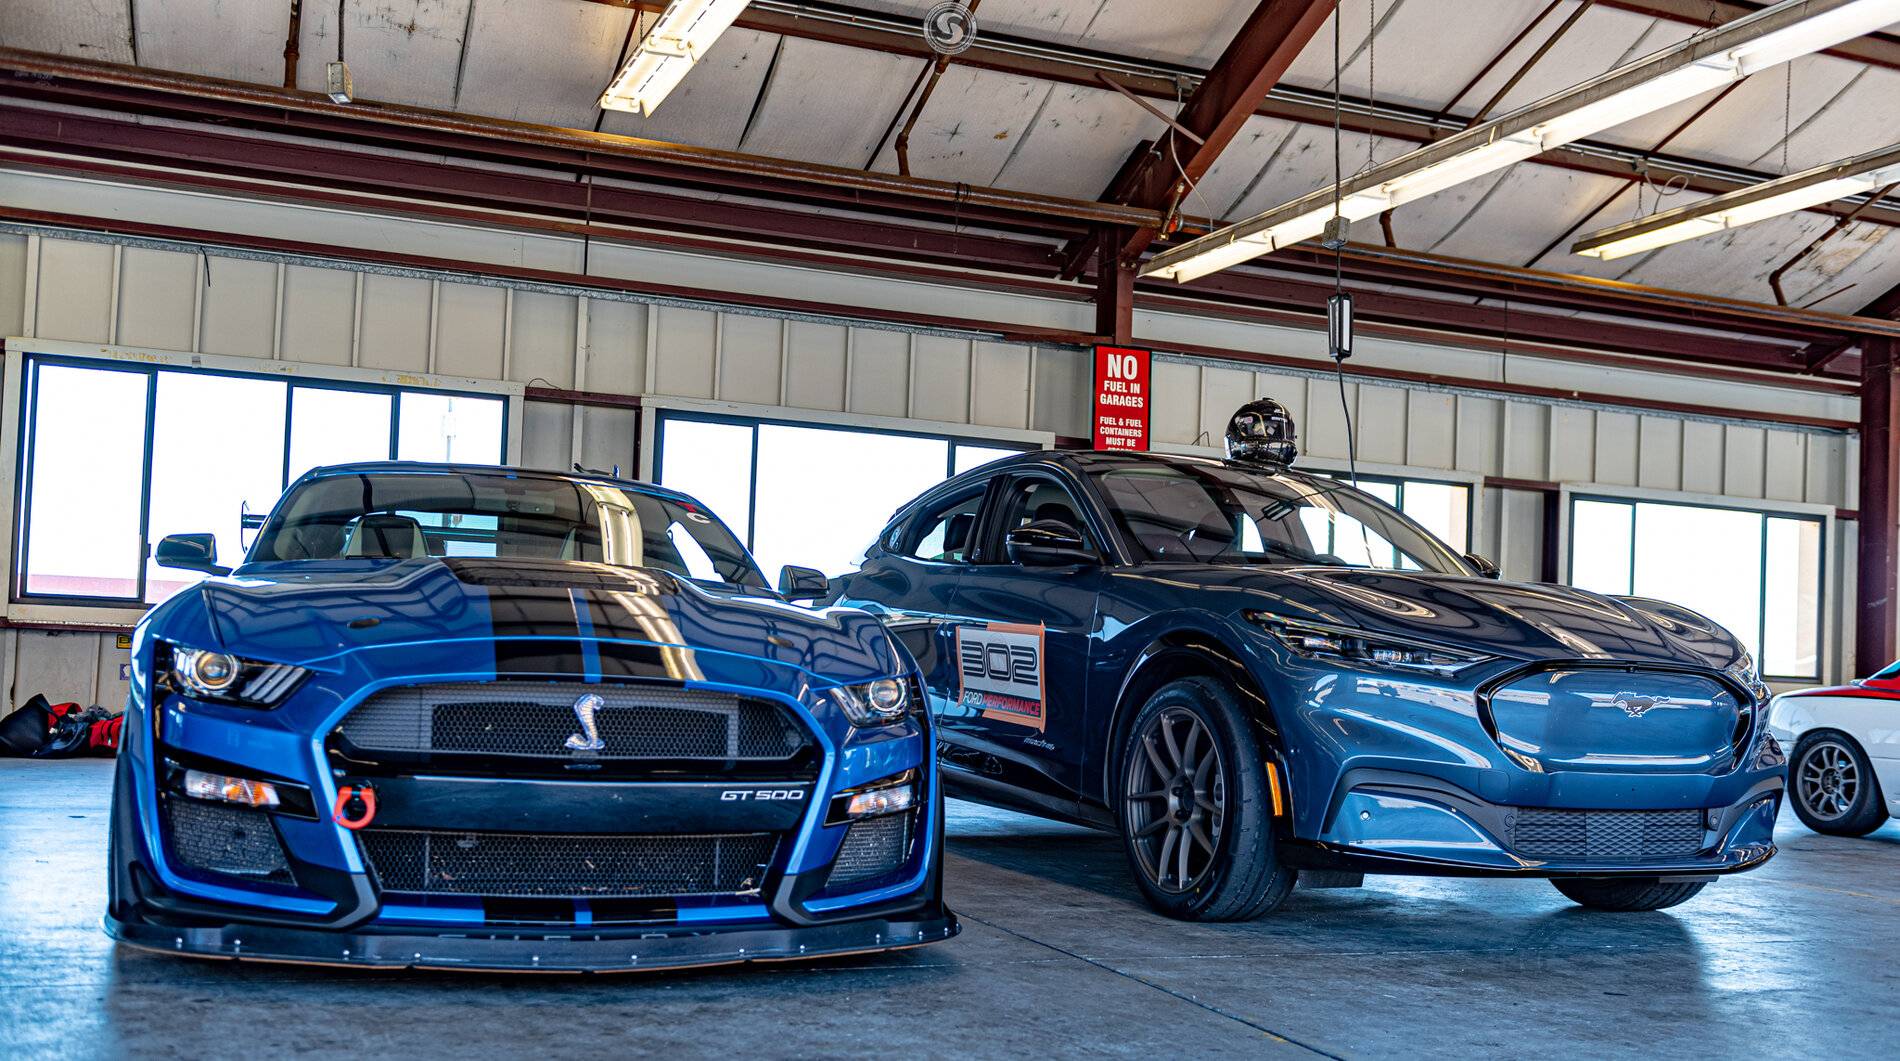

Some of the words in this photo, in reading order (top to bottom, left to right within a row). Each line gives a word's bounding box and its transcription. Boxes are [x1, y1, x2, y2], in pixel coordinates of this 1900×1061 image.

[1107, 353, 1138, 380] NO
[1104, 380, 1128, 393] FUEL
[1130, 383, 1140, 394] IN
[1100, 394, 1144, 408] GARAGES
[1100, 416, 1117, 425] FUEL
[1118, 418, 1124, 426] &
[1125, 418, 1143, 427] FUEL
[1100, 427, 1142, 438] CONTAINERS
[1105, 437, 1125, 446] MUST
[1126, 438, 1136, 447] BE
[961, 640, 1038, 686] 302
[962, 690, 984, 705] FORD
[983, 693, 1041, 716] PERFORMANCE
